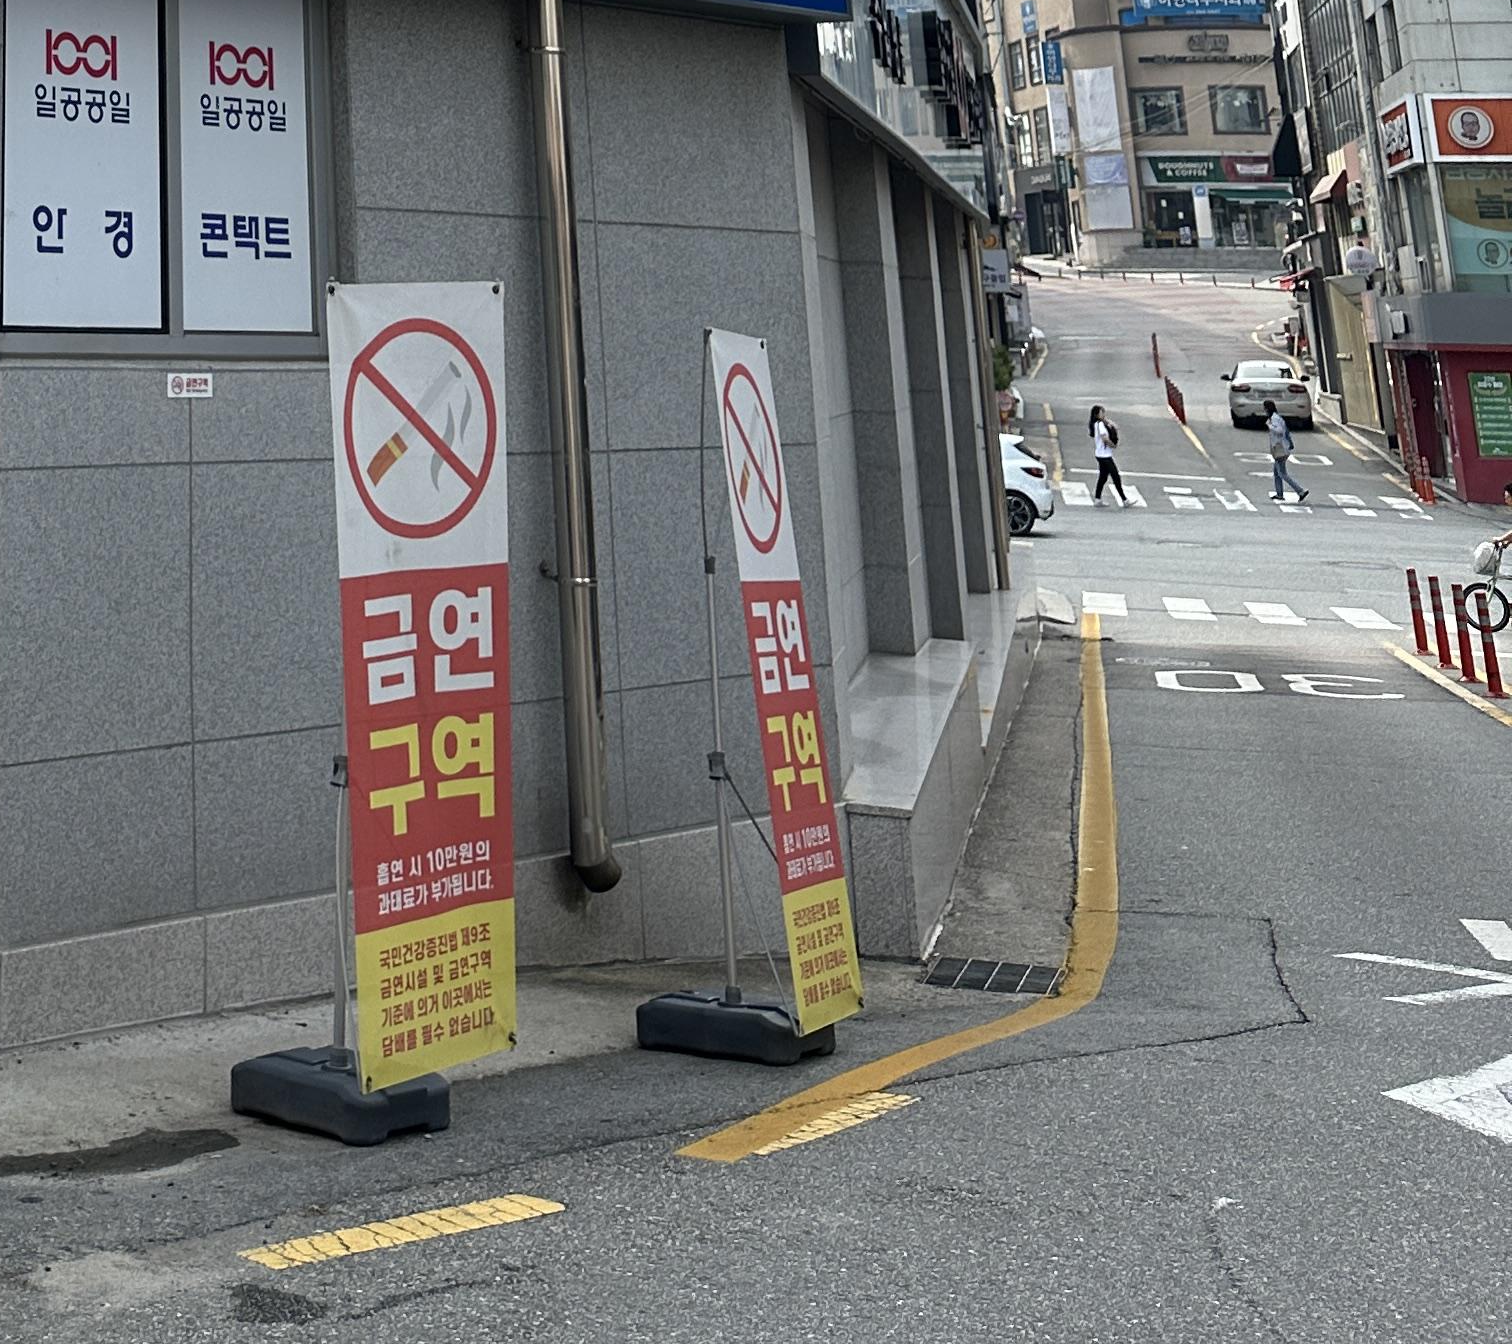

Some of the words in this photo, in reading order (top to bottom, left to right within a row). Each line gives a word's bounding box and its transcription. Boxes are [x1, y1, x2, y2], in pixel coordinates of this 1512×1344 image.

[34, 83, 131, 125] 일공공일
[200, 93, 287, 133] 일공공일
[362, 586, 496, 706] 금연
[751, 599, 810, 694] 금연
[369, 712, 496, 836] 구역
[766, 710, 827, 811] 구역
[376, 861, 404, 887] 흡연
[409, 855, 422, 878] 시
[426, 840, 491, 874] 10만원의
[378, 884, 428, 915] 과태료가
[380, 969, 428, 1000] 금연시설
[433, 965, 444, 986] 및
[449, 949, 492, 979] 금연구역
[381, 1000, 414, 1028] 기준에
[418, 993, 438, 1016] 의거
[442, 979, 492, 1010] 이곳에서는
